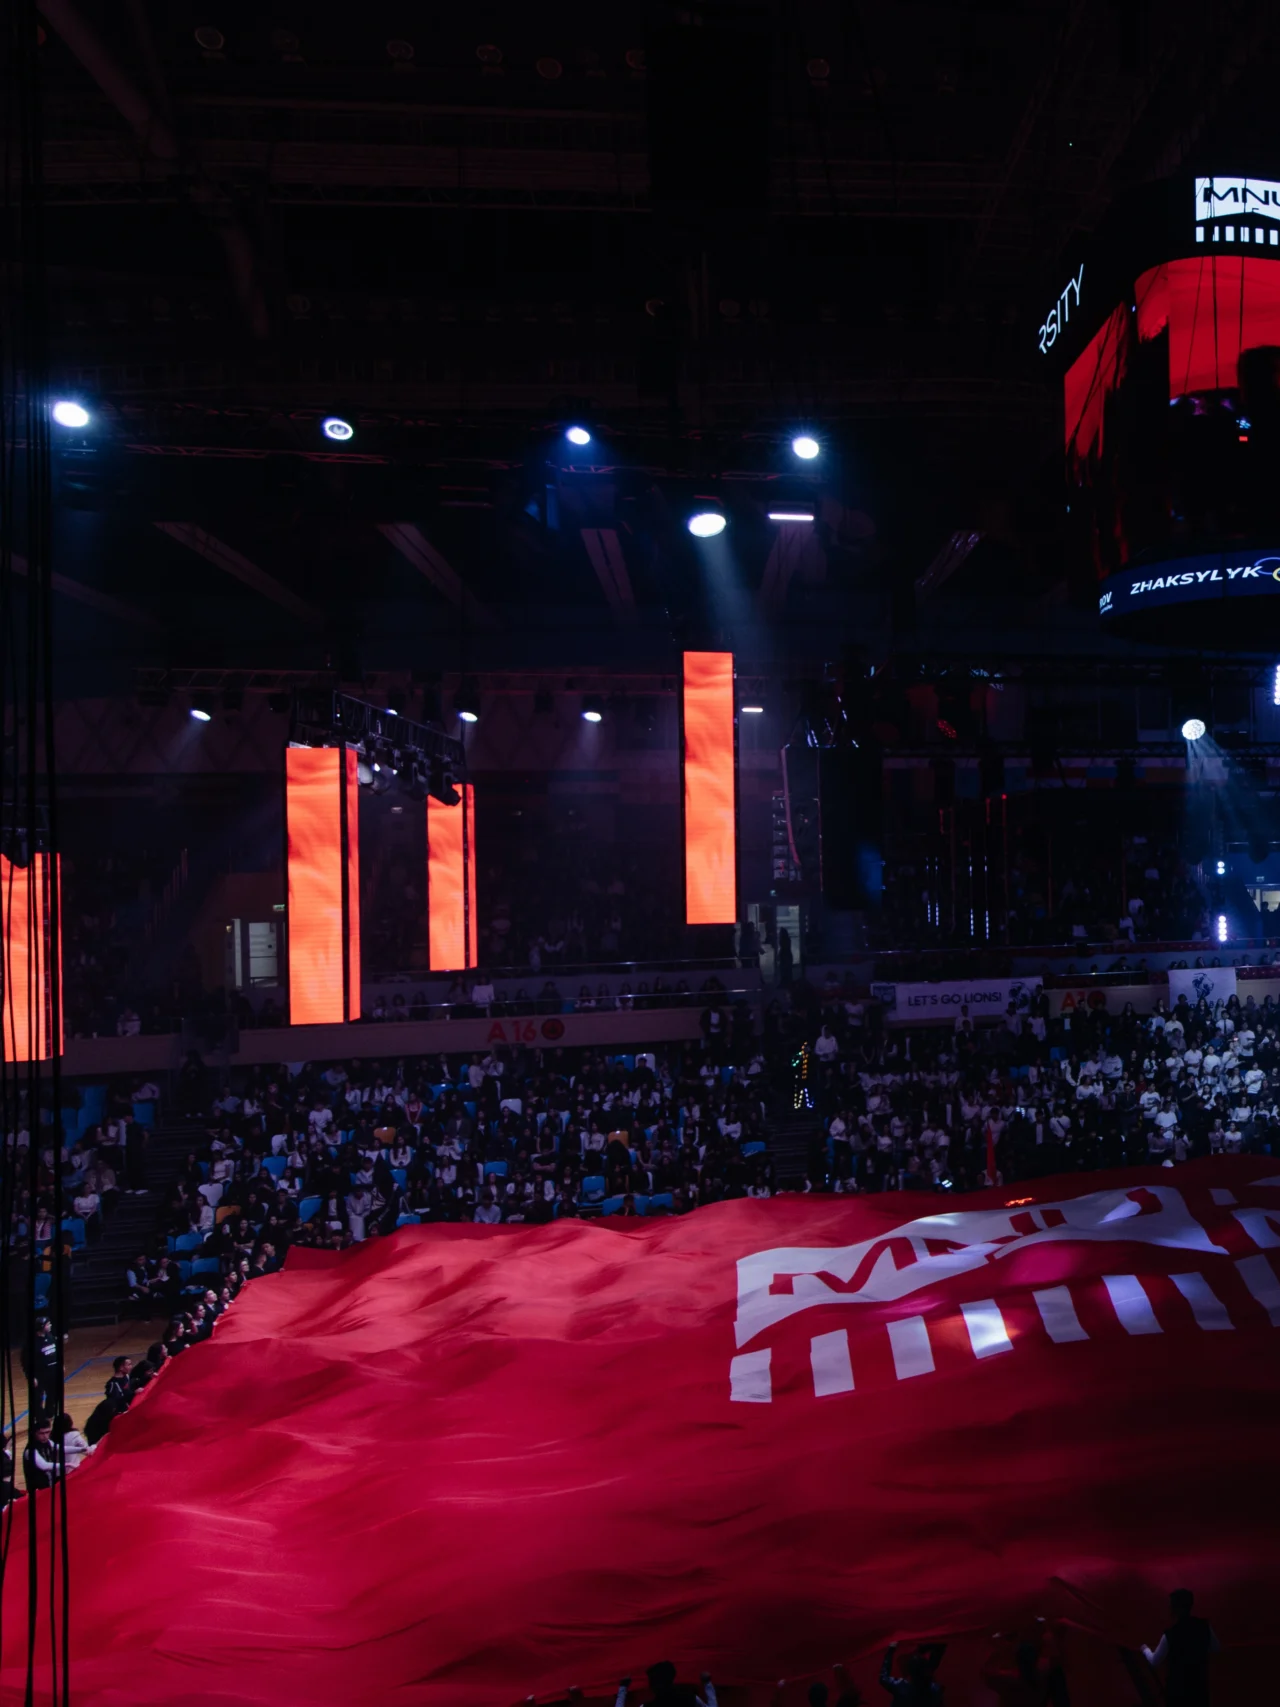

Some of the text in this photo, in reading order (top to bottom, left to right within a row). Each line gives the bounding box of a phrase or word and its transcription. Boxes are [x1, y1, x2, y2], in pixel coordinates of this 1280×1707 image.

[1130, 565, 1263, 595] ZHAKSYLYK
[908, 992, 1002, 1006] LET'S GO LIONS!
